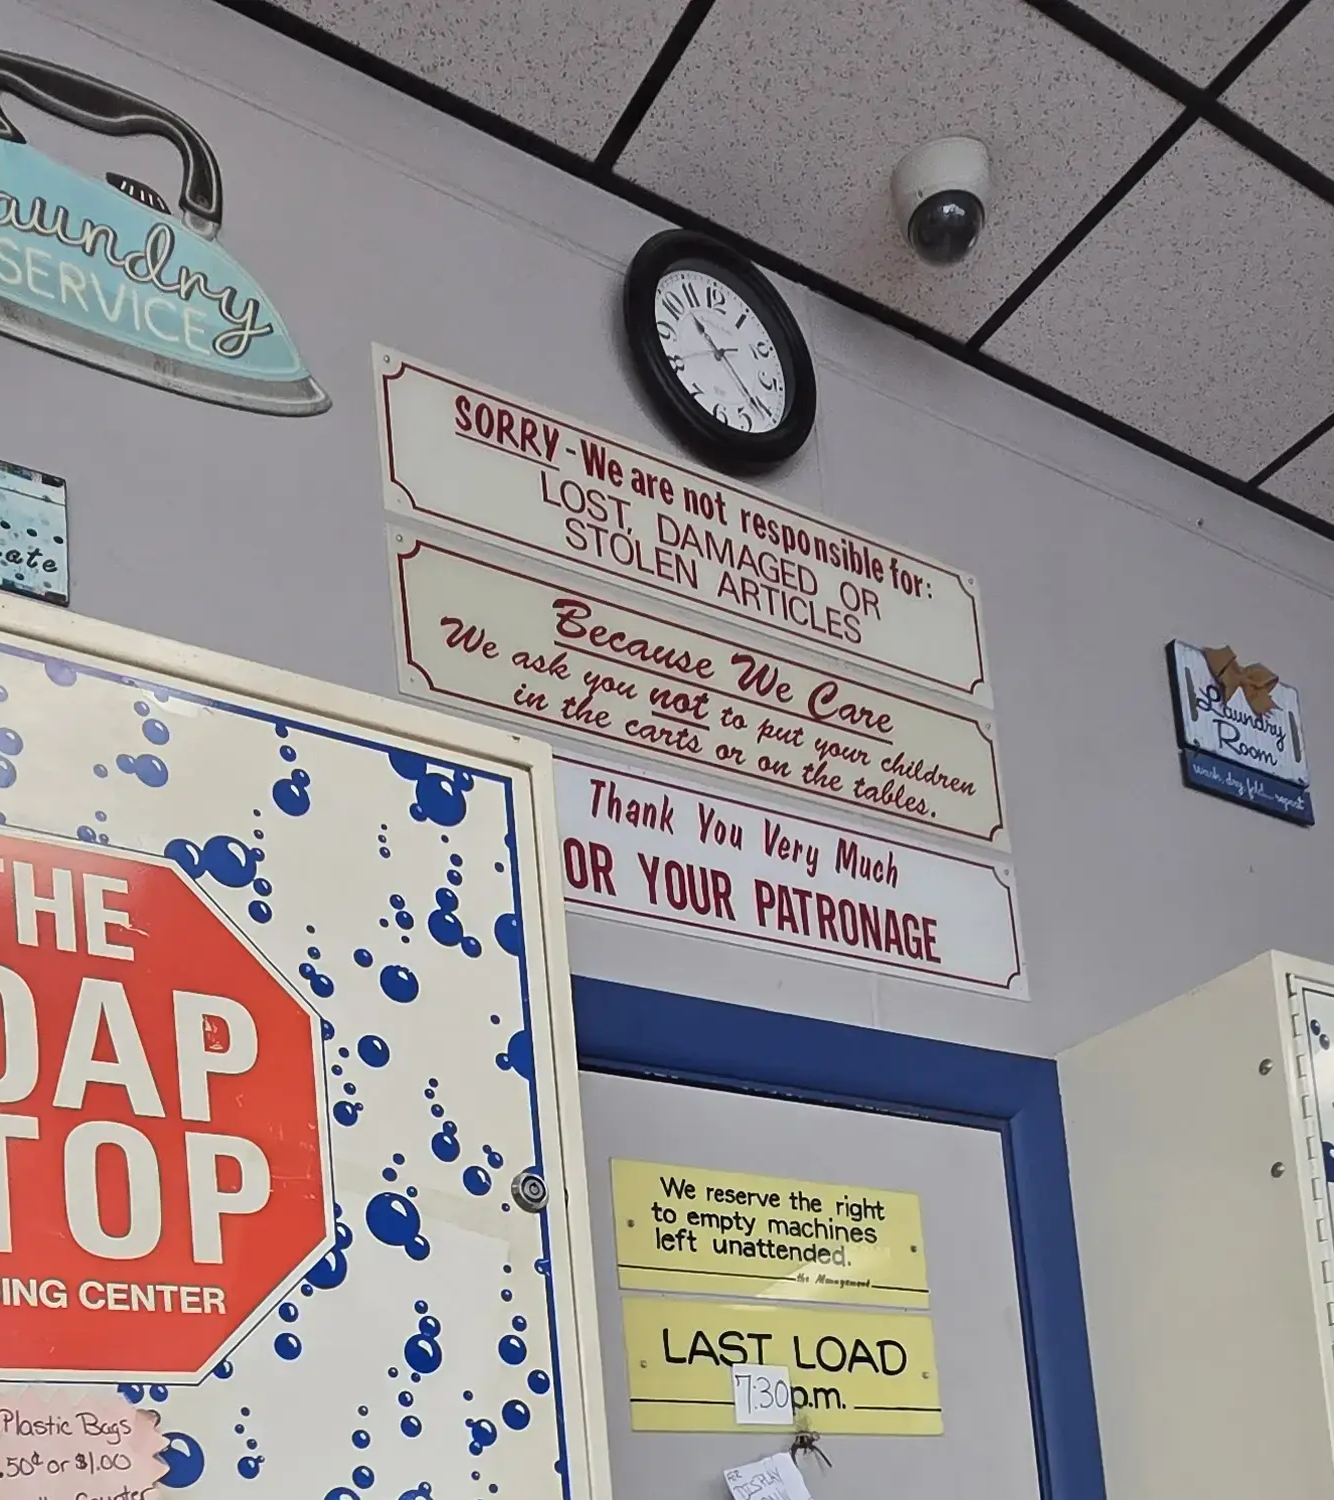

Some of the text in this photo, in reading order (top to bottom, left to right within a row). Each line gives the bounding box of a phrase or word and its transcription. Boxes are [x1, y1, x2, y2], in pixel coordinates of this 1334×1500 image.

[662, 290, 685, 320] 10
[681, 282, 701, 309] 11
[706, 286, 727, 315] 12
[454, 395, 561, 463] SORRY
[580, 438, 624, 487] We
[630, 464, 675, 505] are
[682, 481, 727, 526] not
[739, 506, 885, 585] responsible
[889, 556, 933, 600] for:
[539, 470, 882, 621] LOST, DAMAGED OR
[566, 517, 863, 645] STOLEN ARTICLES
[553, 599, 895, 735] Because We Care
[440, 616, 977, 797] We ask you not to put your children
[1196, 683, 1286, 752] Laundry
[513, 683, 938, 820] in the carts or on the tables.
[1212, 718, 1278, 767] Room
[589, 778, 900, 889] Thank You Very Much
[565, 837, 943, 965] OR YOUR PATRONAGE
[659, 1176, 886, 1222] We reserve the right
[651, 1202, 879, 1244] to empty machines
[655, 1227, 853, 1267] left unattended.
[77, 1279, 227, 1315] CENTER
[662, 1328, 908, 1376] LAST LOAD
[734, 1374, 789, 1414] 7:30
[75, 1412, 133, 1445] Bags
[47, 1459, 71, 1474] or
[75, 1451, 132, 1475] $1.00
[733, 1466, 784, 1500] DISPLAY
